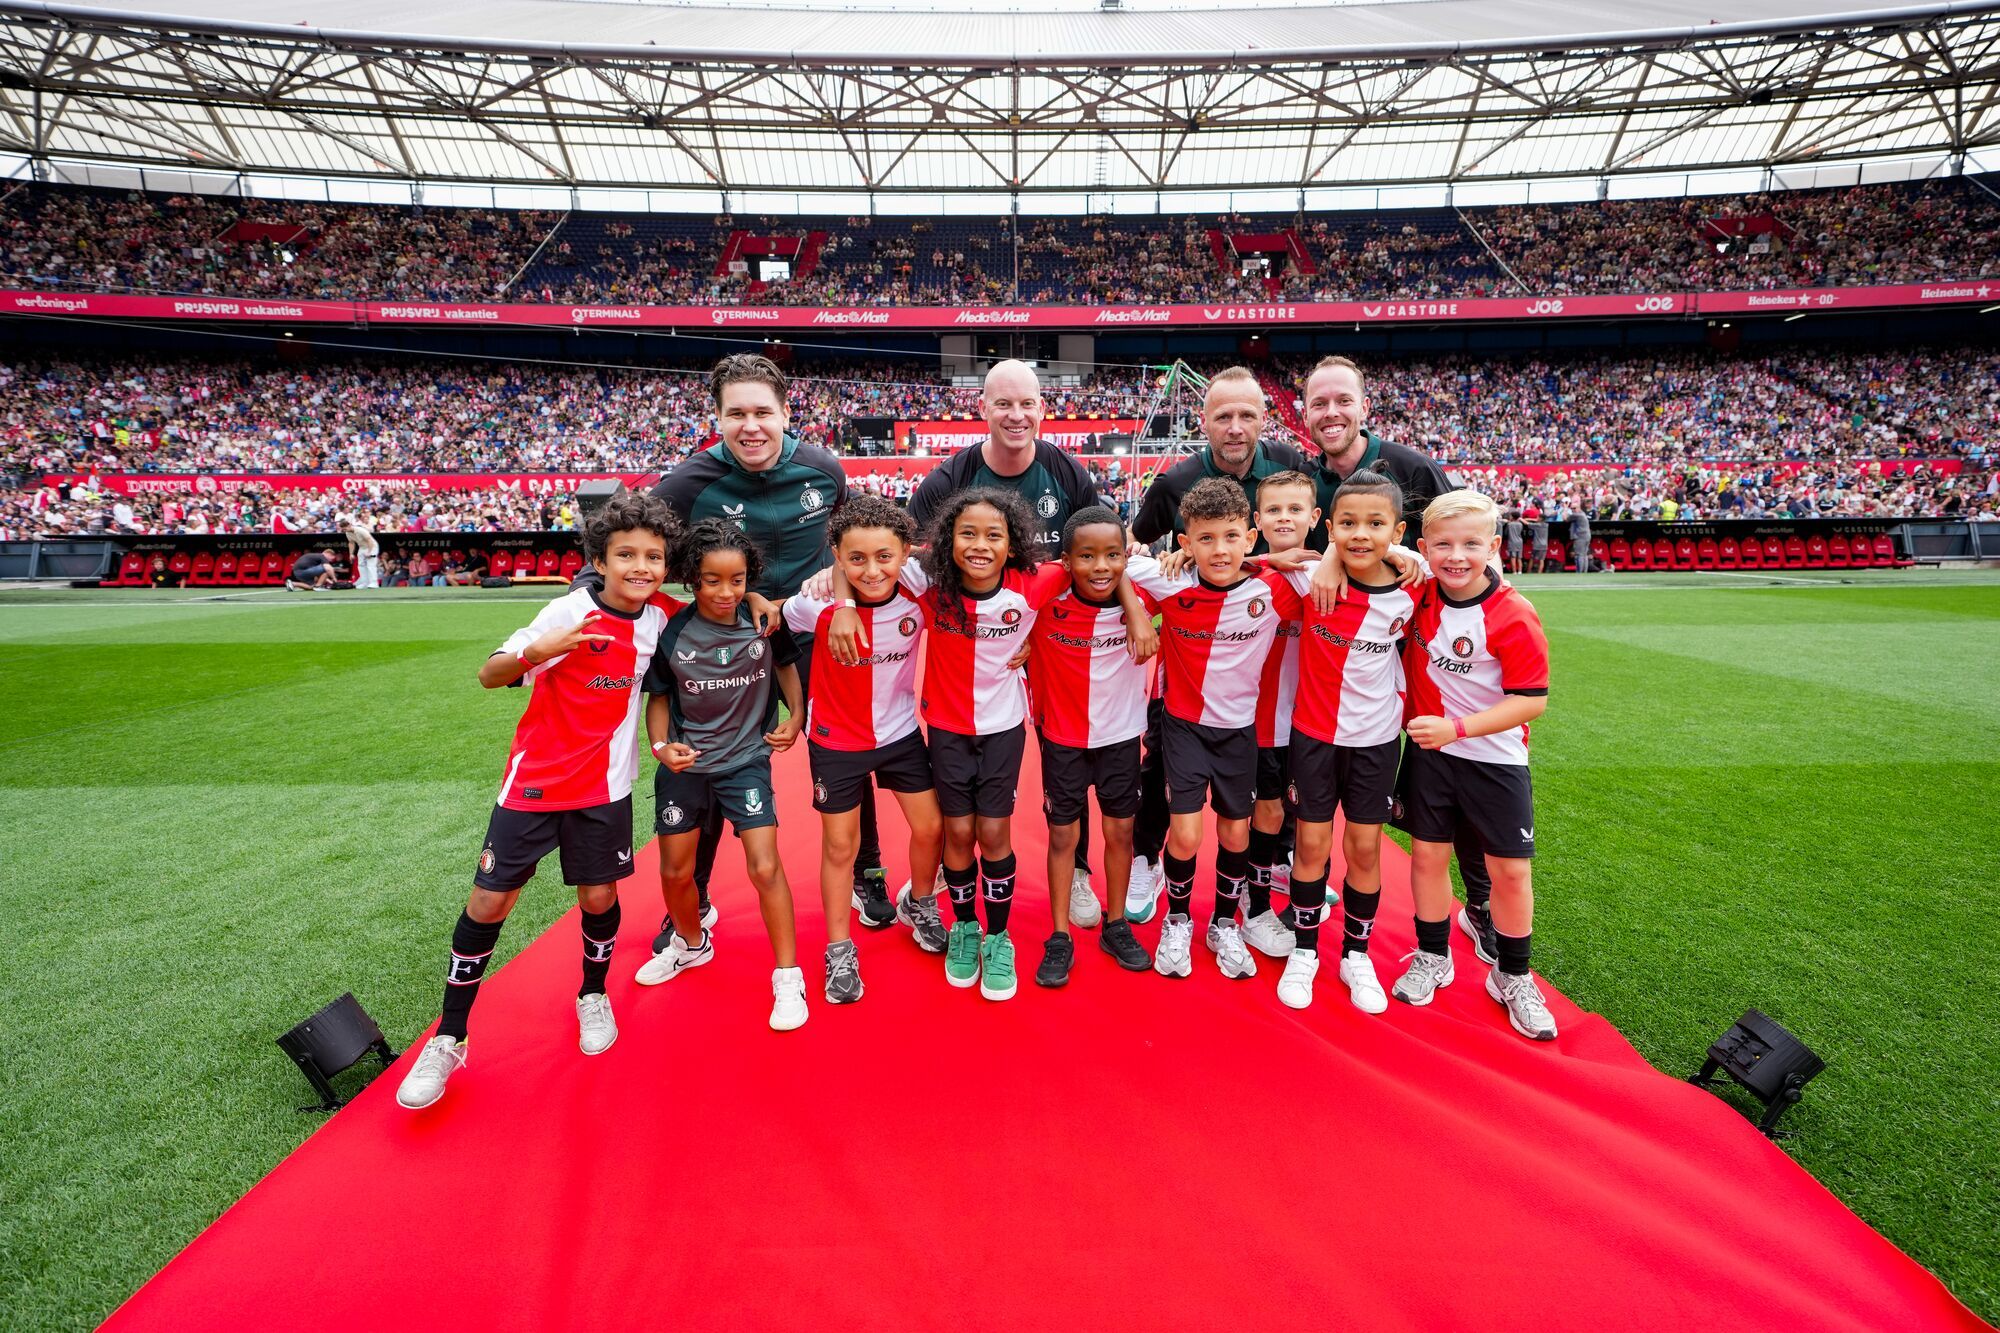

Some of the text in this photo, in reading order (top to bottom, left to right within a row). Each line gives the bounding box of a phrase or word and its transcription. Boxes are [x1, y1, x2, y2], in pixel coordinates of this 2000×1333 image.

[1921, 287, 1974, 298] Heineken
[1748, 295, 1796, 306] Heineken
[244, 305, 303, 316] vakanties
[444, 309, 498, 319] vakanties
[571, 308, 641, 323] QTERMINALS
[712, 309, 779, 324] QTERMINALS
[1228, 307, 1296, 319] CASTORE
[1387, 304, 1458, 316] CASTORE
[985, 624, 1020, 638] Markt
[1224, 629, 1260, 642] Markt
[1048, 632, 1088, 648] Media
[1310, 624, 1392, 654] Media Markt
[1432, 656, 1473, 674] Markt
[585, 675, 633, 690] Media
[685, 668, 766, 694] QTERMINALS
[984, 880, 1009, 900] F
[1294, 907, 1315, 927] F
[447, 956, 482, 982] F
